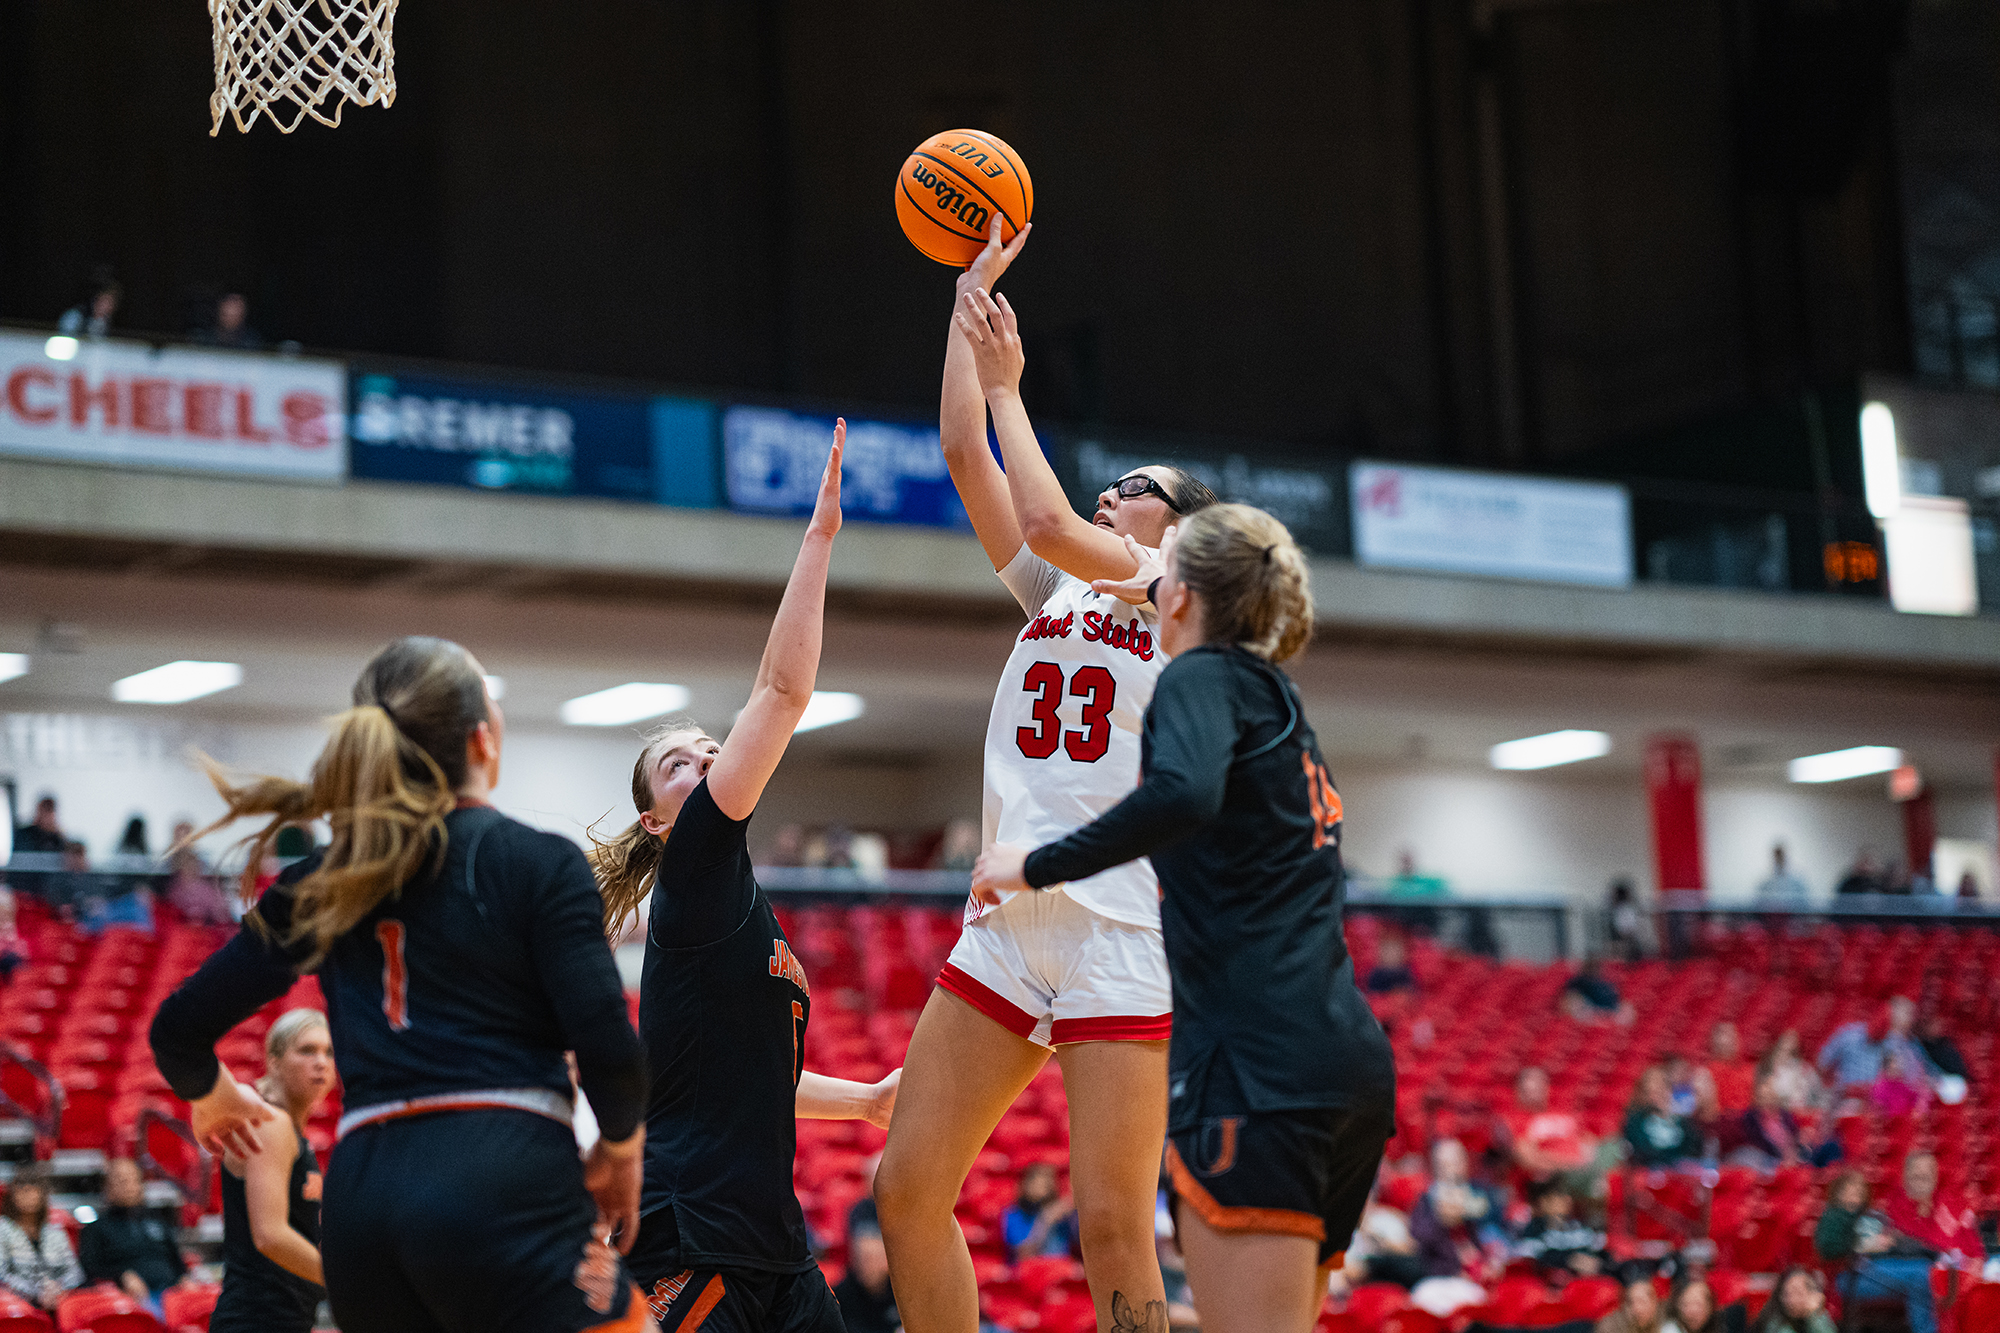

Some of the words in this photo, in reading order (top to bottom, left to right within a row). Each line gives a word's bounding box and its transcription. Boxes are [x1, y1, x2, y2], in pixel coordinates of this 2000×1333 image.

[950, 142, 1004, 178] EVO
[912, 162, 988, 233] Wilson
[1021, 609, 1074, 642] inot
[1082, 610, 1154, 662] State
[1016, 660, 1116, 763] 33
[374, 918, 412, 1033] 1
